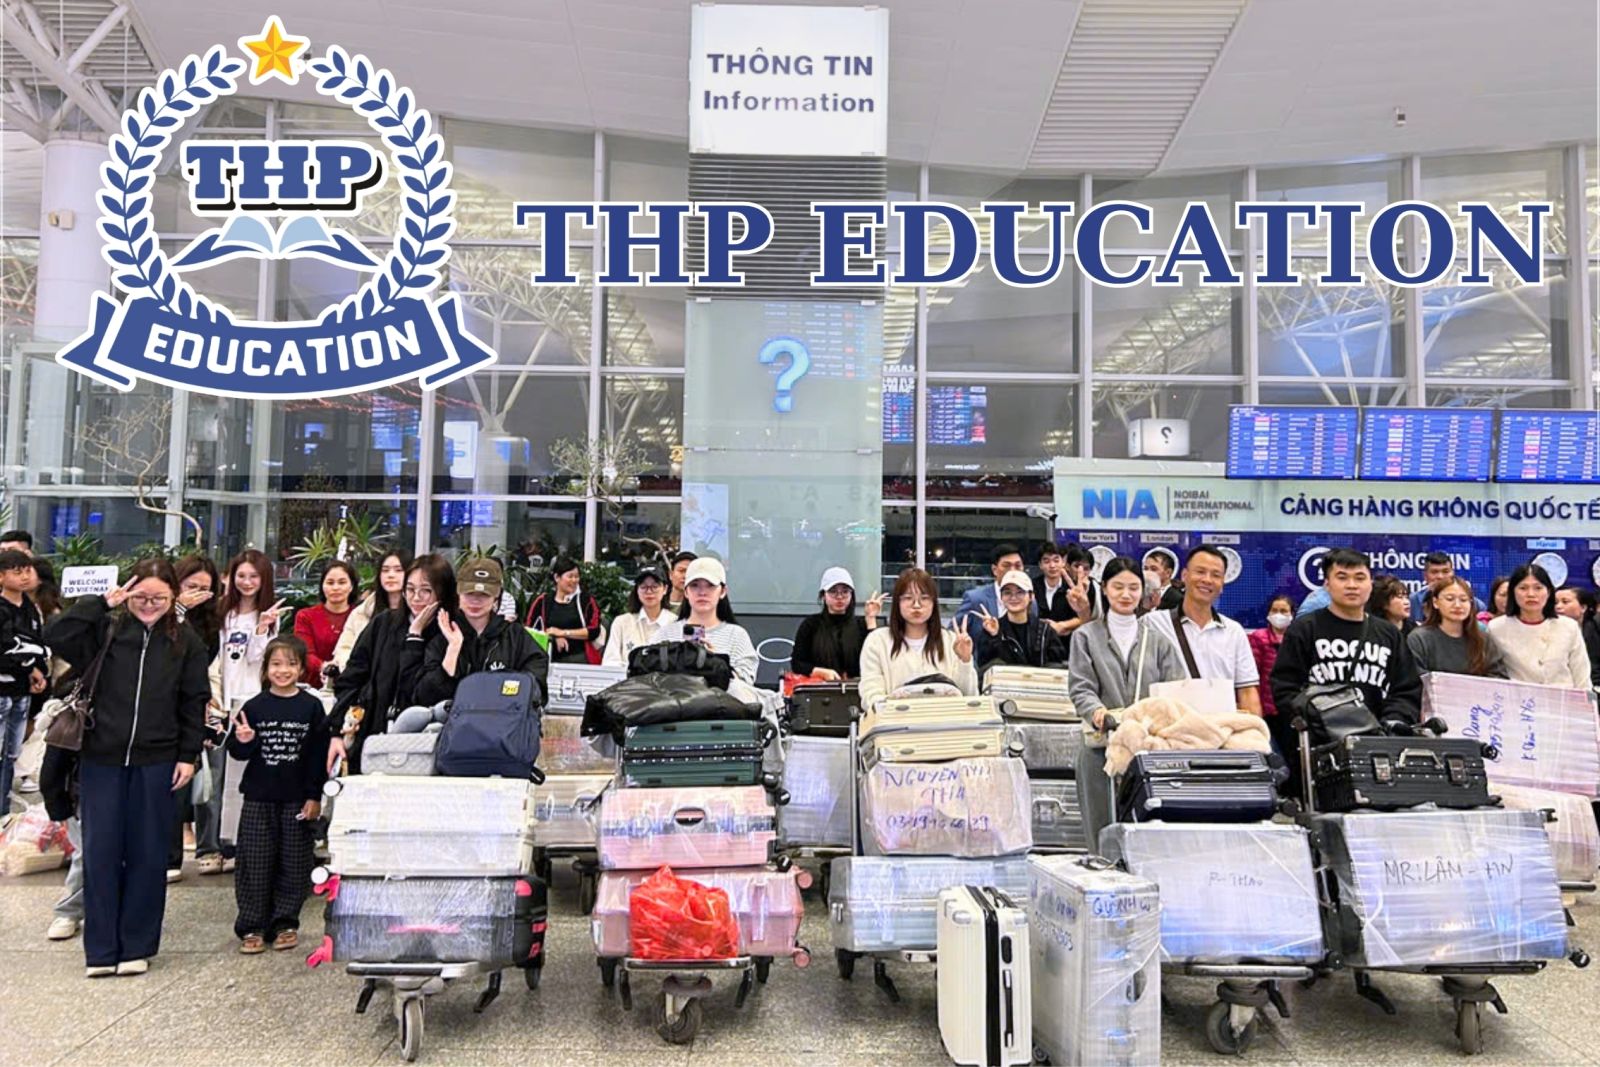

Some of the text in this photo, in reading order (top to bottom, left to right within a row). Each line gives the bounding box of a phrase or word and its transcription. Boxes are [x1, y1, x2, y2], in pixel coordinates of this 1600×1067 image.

[707, 47, 874, 76] THÔNG TIN
[703, 90, 875, 113] Information
[1082, 488, 1160, 520] NIA
[1173, 490, 1210, 500] NOIBAI
[1173, 500, 1255, 511] INTERNATIONAL
[1173, 511, 1221, 521] AIRPORT
[1280, 492, 1343, 517] CẢNG
[1349, 495, 1413, 518] HÀNG
[1418, 495, 1500, 519] KHÔNG
[1504, 496, 1572, 521] QUỐC
[1362, 548, 1428, 570] HÔNG
[1447, 553, 1471, 570] IN
